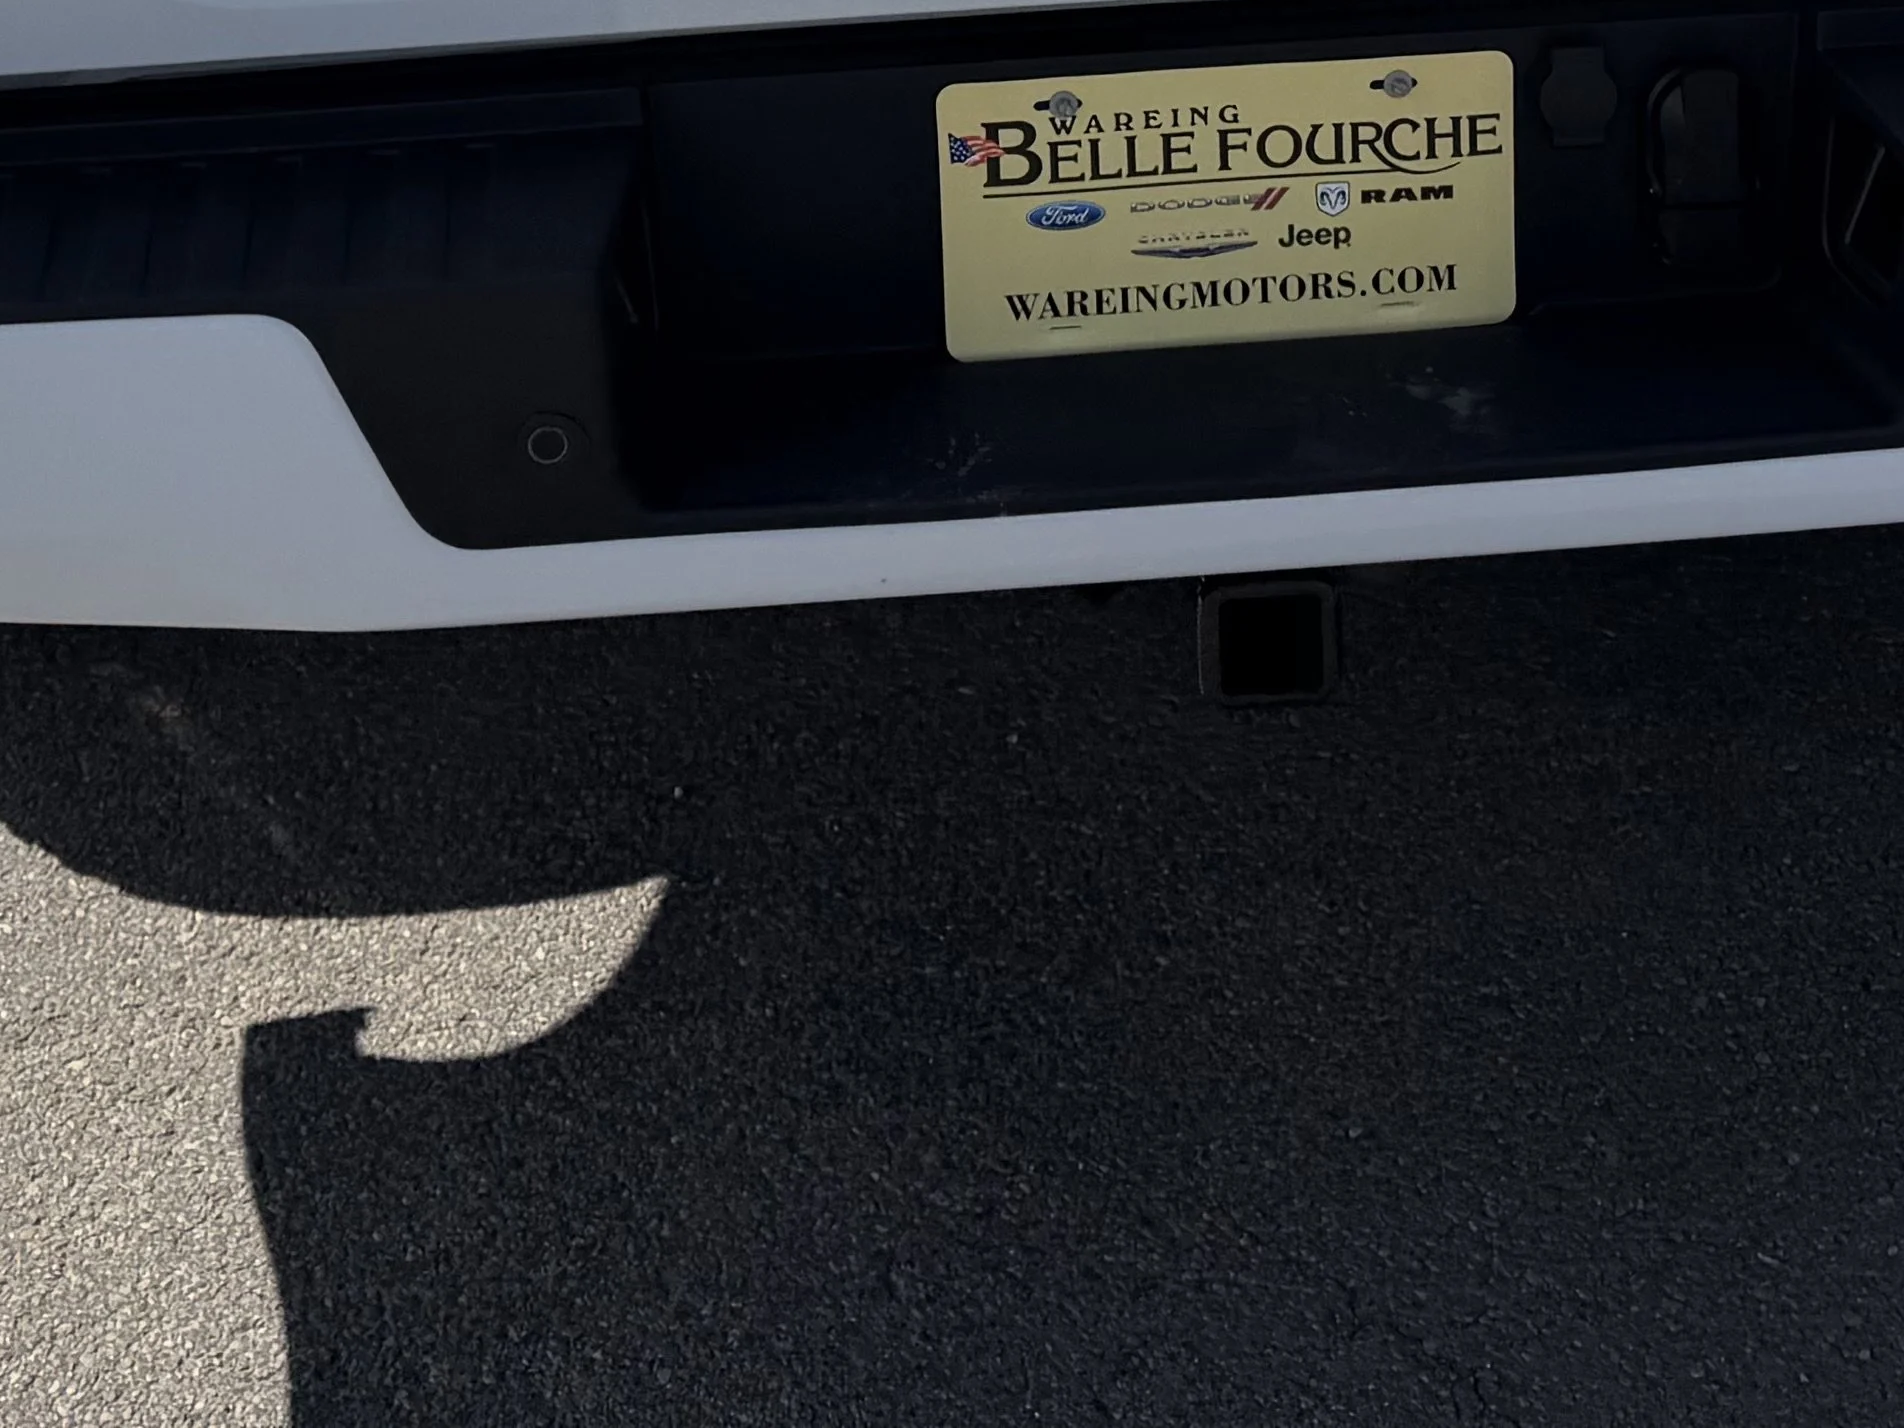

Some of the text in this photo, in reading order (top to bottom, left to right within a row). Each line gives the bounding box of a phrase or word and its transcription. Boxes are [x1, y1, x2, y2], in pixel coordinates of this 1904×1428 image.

[1047, 104, 1240, 136] WAREING
[981, 113, 1503, 188] BELLE FOURCHE
[1041, 204, 1088, 228] Ford
[1361, 185, 1454, 204] RAM
[1278, 224, 1352, 249] Jeep
[1004, 263, 1458, 322] WAREINGMOTORS.COM
